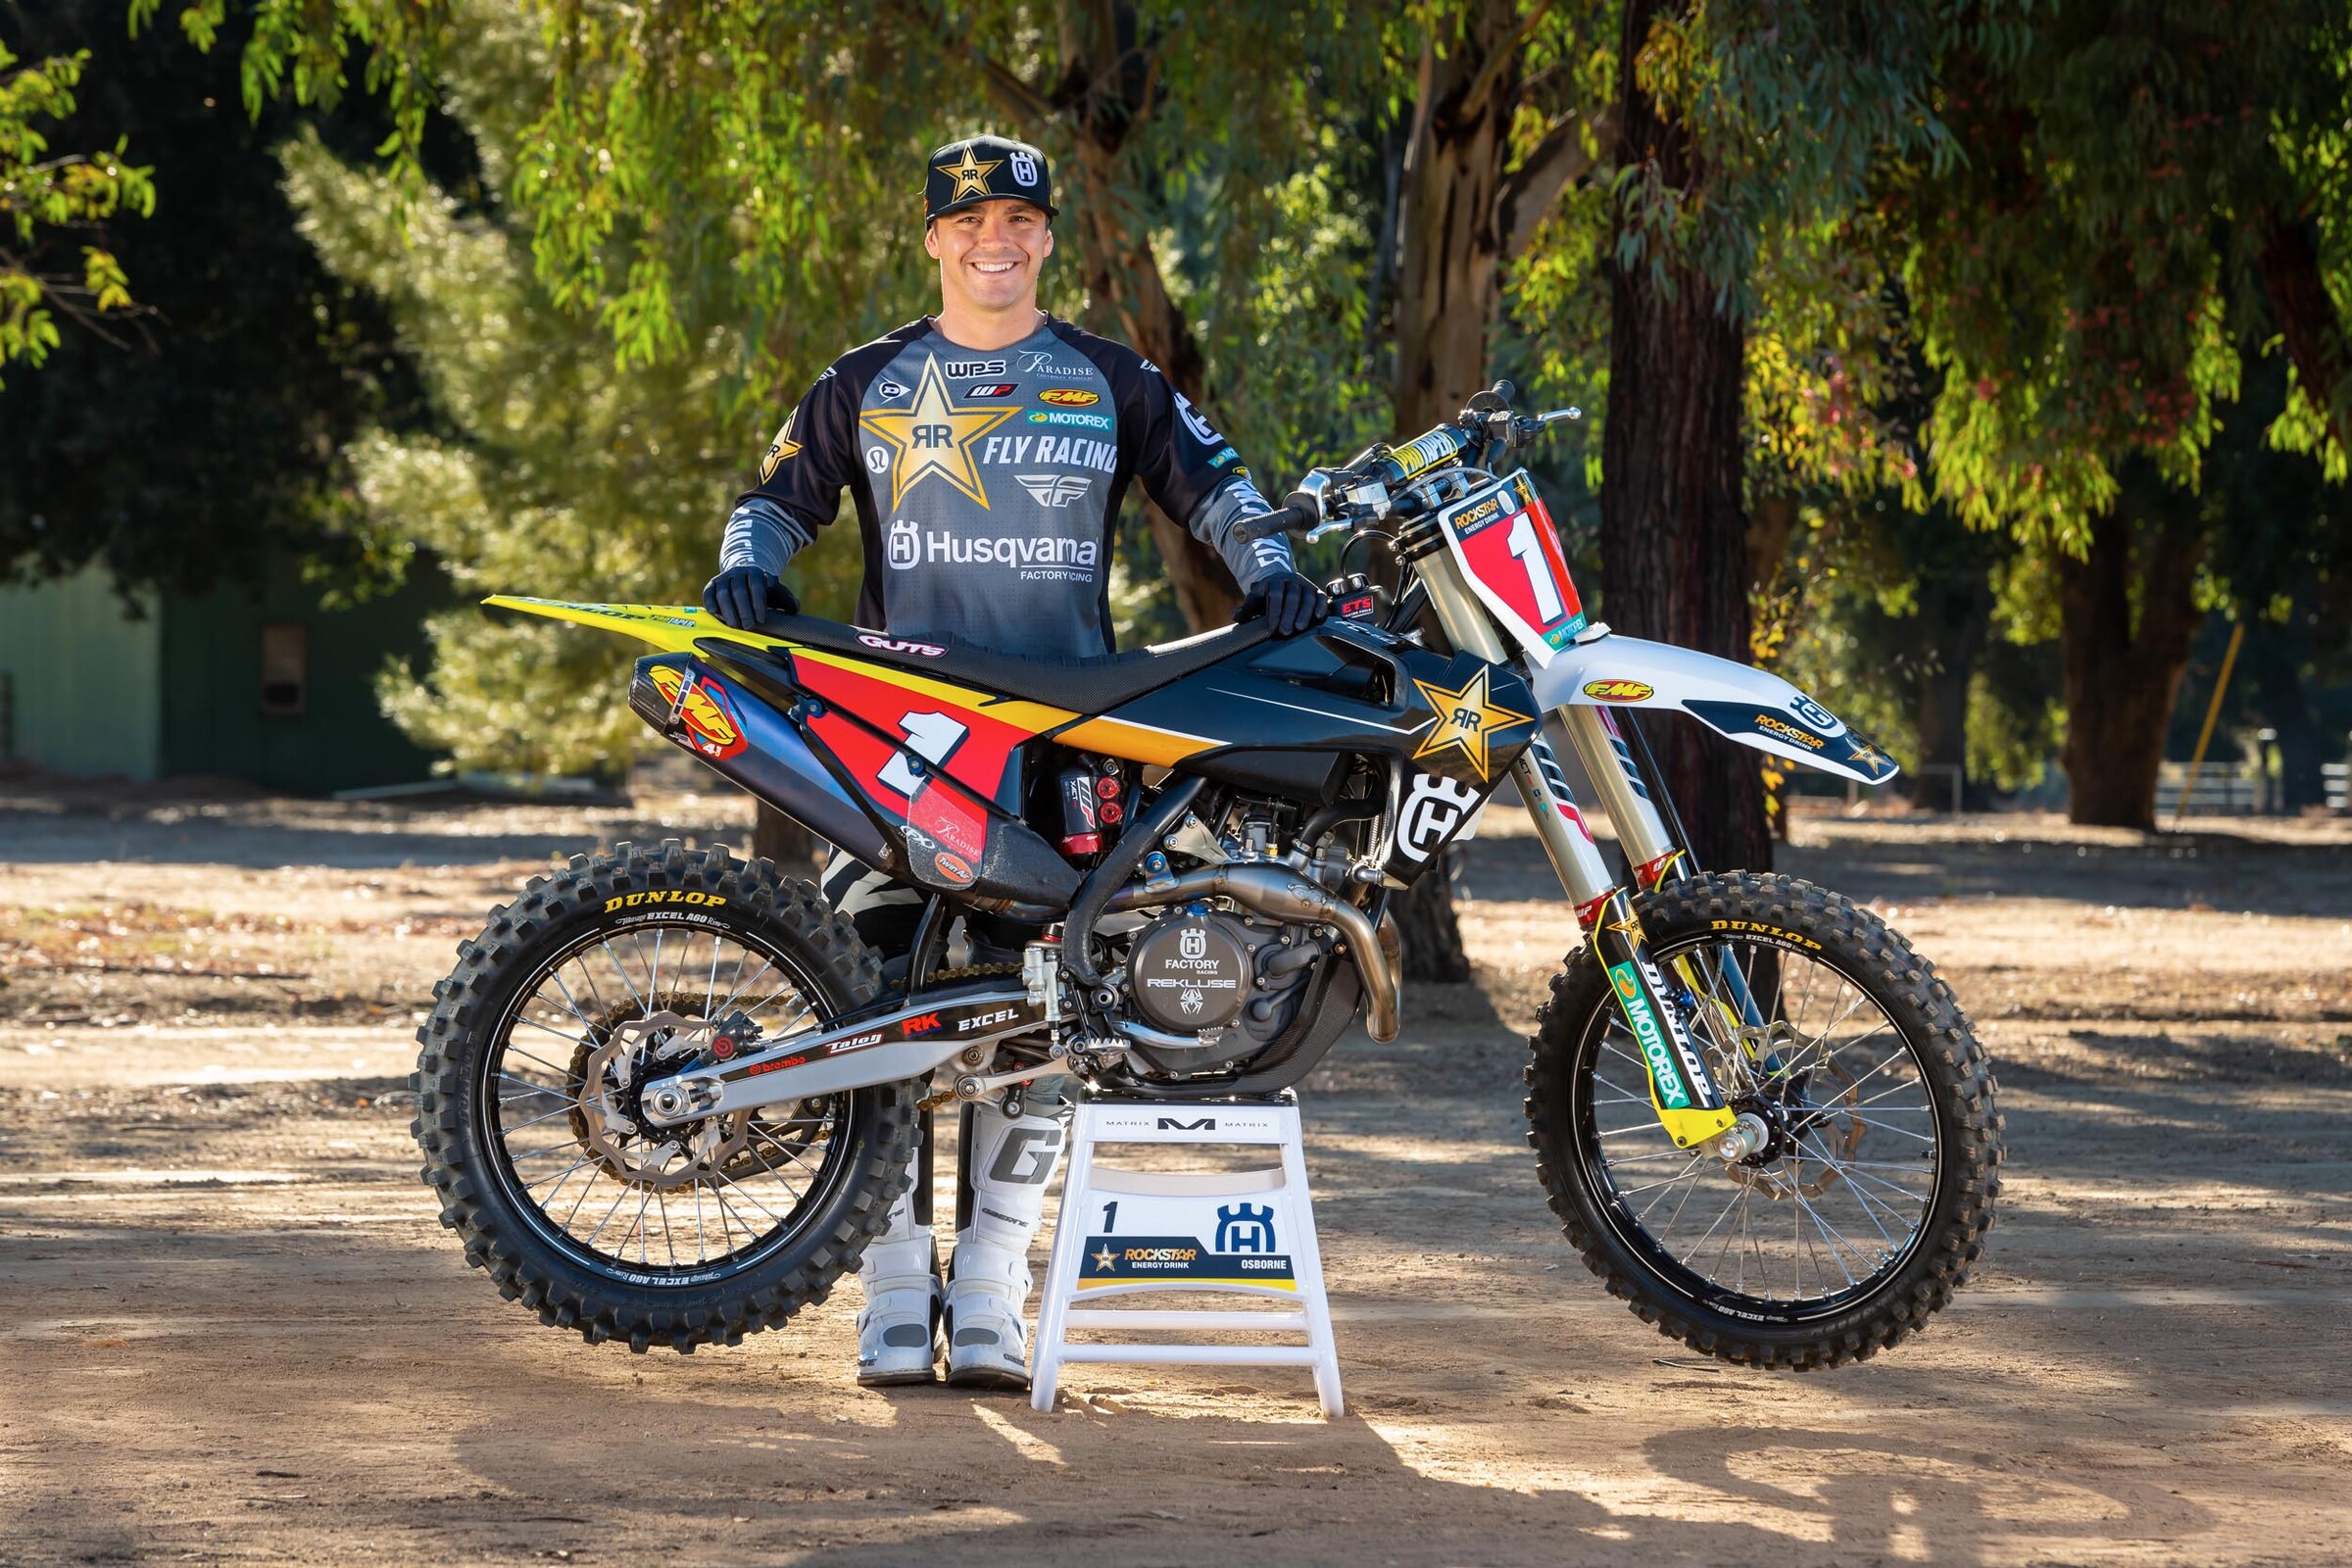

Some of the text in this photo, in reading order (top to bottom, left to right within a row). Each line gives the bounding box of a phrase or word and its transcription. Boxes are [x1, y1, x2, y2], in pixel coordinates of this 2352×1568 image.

[946, 360, 1005, 379] WPS
[970, 384, 1013, 397] WP
[1039, 391, 1100, 403] FMF
[1050, 413, 1108, 429] MOTOREX
[983, 436, 1117, 474] FLY RACING
[1454, 499, 1498, 529] ROCKSTAR
[1464, 514, 1500, 535] ENERGY DRINK
[926, 531, 1097, 568] Husqvarna
[1020, 571, 1068, 580] FACTORY
[1507, 512, 1563, 625] 1
[1343, 598, 1371, 613] ETS
[858, 635, 947, 656] GUTS
[1585, 683, 1652, 697] FMF
[648, 668, 737, 740] FMF
[1755, 714, 1825, 749] ROCKSTAR
[1758, 725, 1814, 752] ENERGY DRINK
[876, 711, 969, 796] 1
[1519, 758, 1532, 774] ACT
[605, 891, 726, 913] DUNLOP
[647, 911, 684, 920] EXCEL
[686, 912, 708, 923] A60
[1711, 920, 1822, 951] DUNLOP
[1745, 934, 1774, 944] EXCEL
[1775, 939, 1792, 949] A60
[1165, 959, 1219, 969] FACTORY
[1148, 978, 1236, 988] REKLUSE
[902, 1012, 941, 1035] RK
[957, 1008, 1019, 1032] EXCEL
[1643, 961, 1711, 1107] DUNLOP
[1627, 999, 1684, 1104] MOTOREX
[762, 1056, 807, 1073] brembo
[1102, 1201, 1118, 1233] 1
[1124, 1248, 1198, 1260] ROCKSTAR
[1241, 1259, 1287, 1270] OSBORNE
[628, 1274, 649, 1284] A60
[652, 1276, 689, 1285] EXCEL
